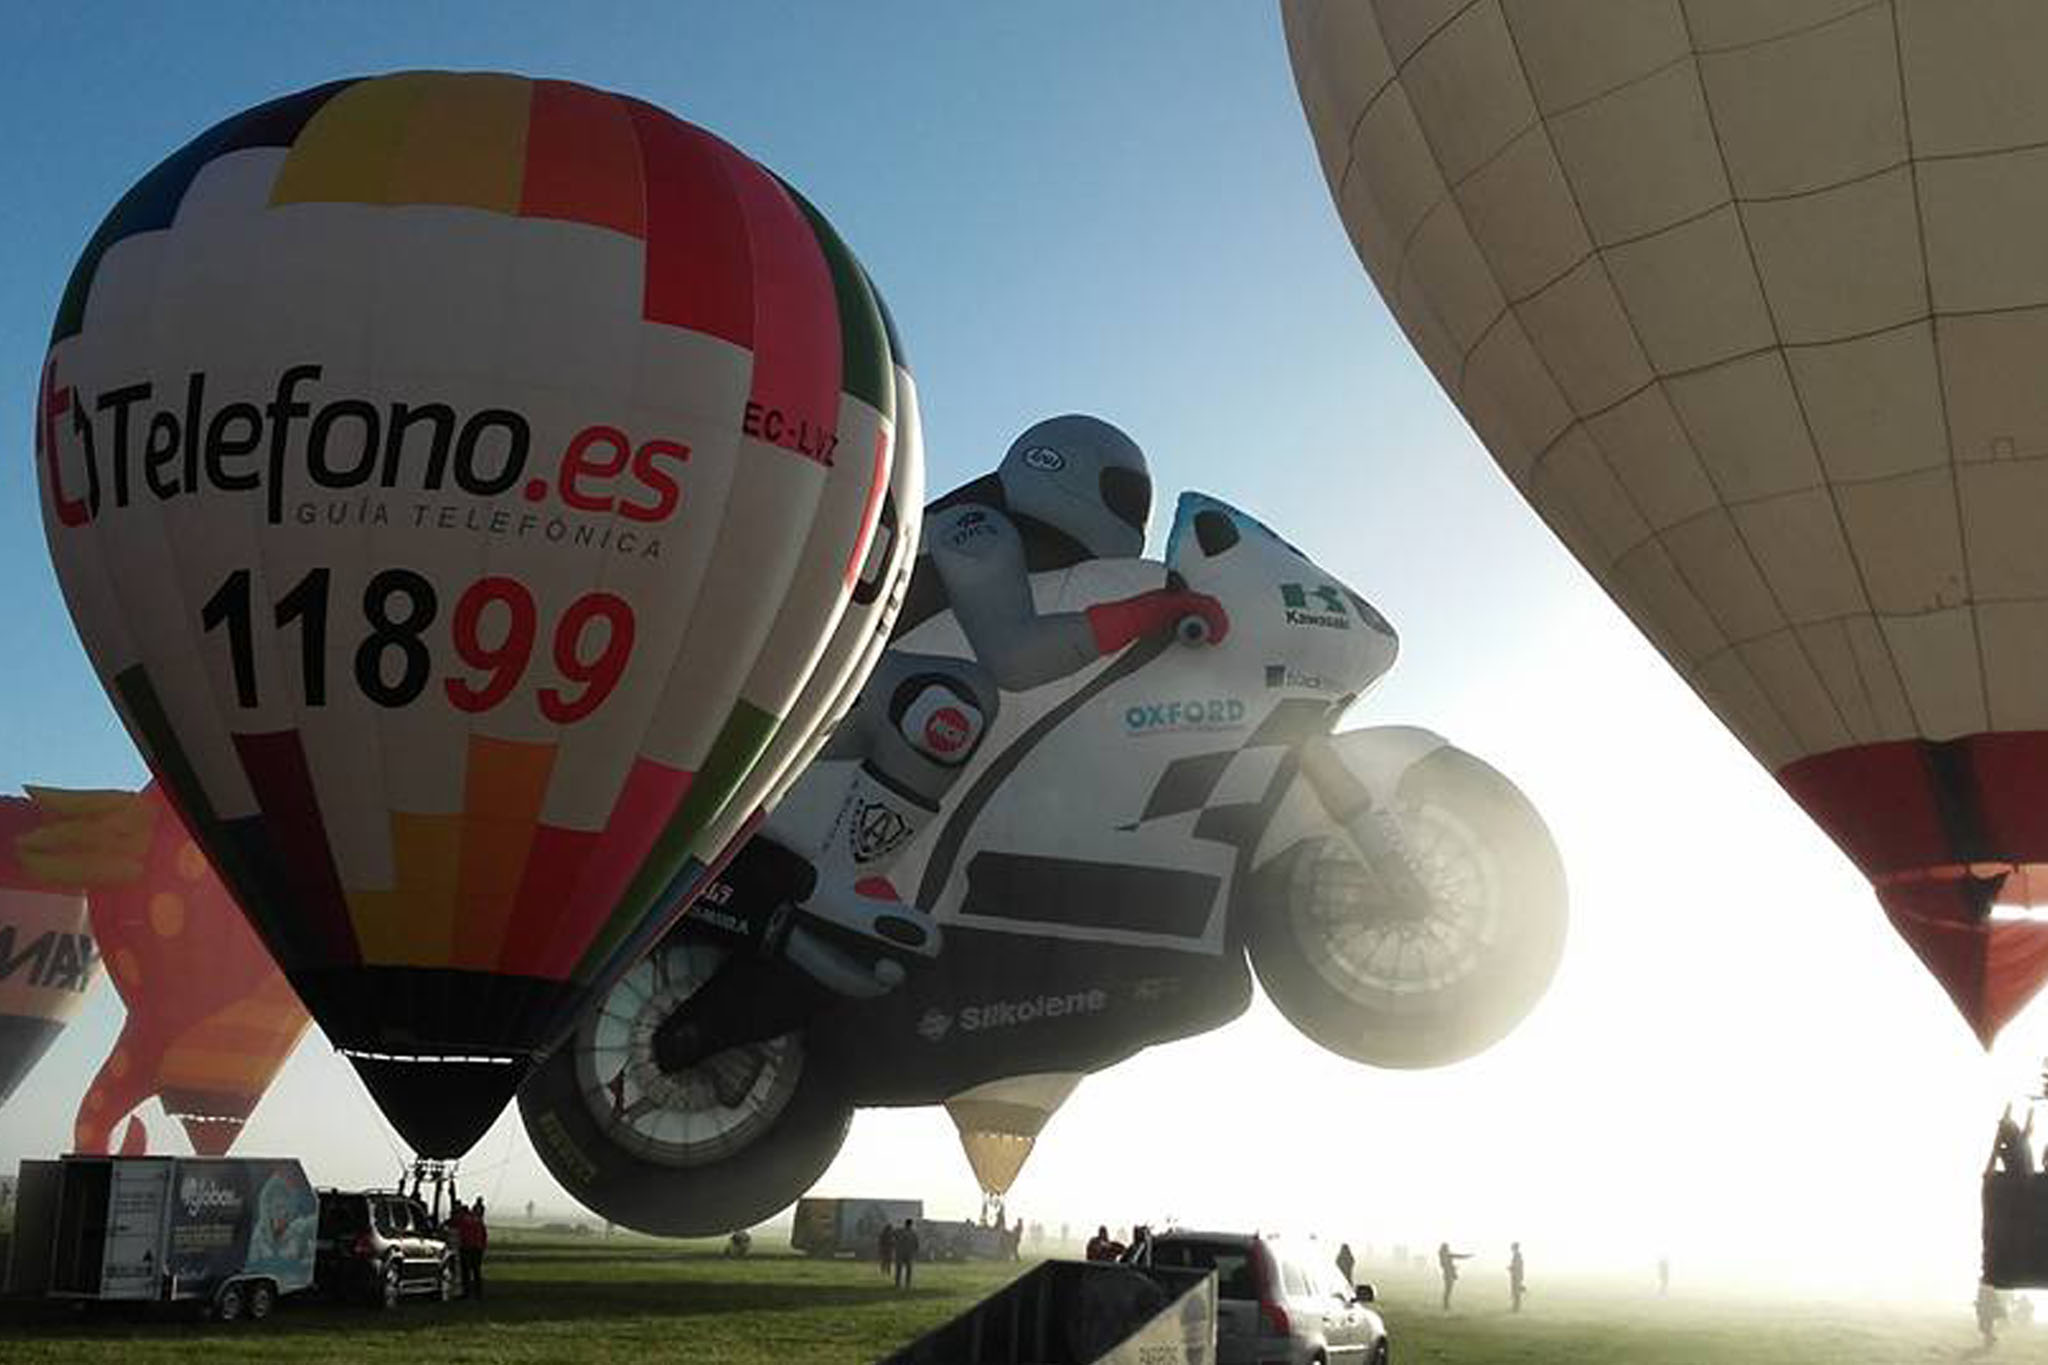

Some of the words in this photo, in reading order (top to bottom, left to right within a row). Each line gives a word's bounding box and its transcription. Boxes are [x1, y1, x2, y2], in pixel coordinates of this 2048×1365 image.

[99, 364, 691, 526] Telefono.es
[201, 566, 637, 726] 11899
[1125, 700, 1246, 728] OXFORD
